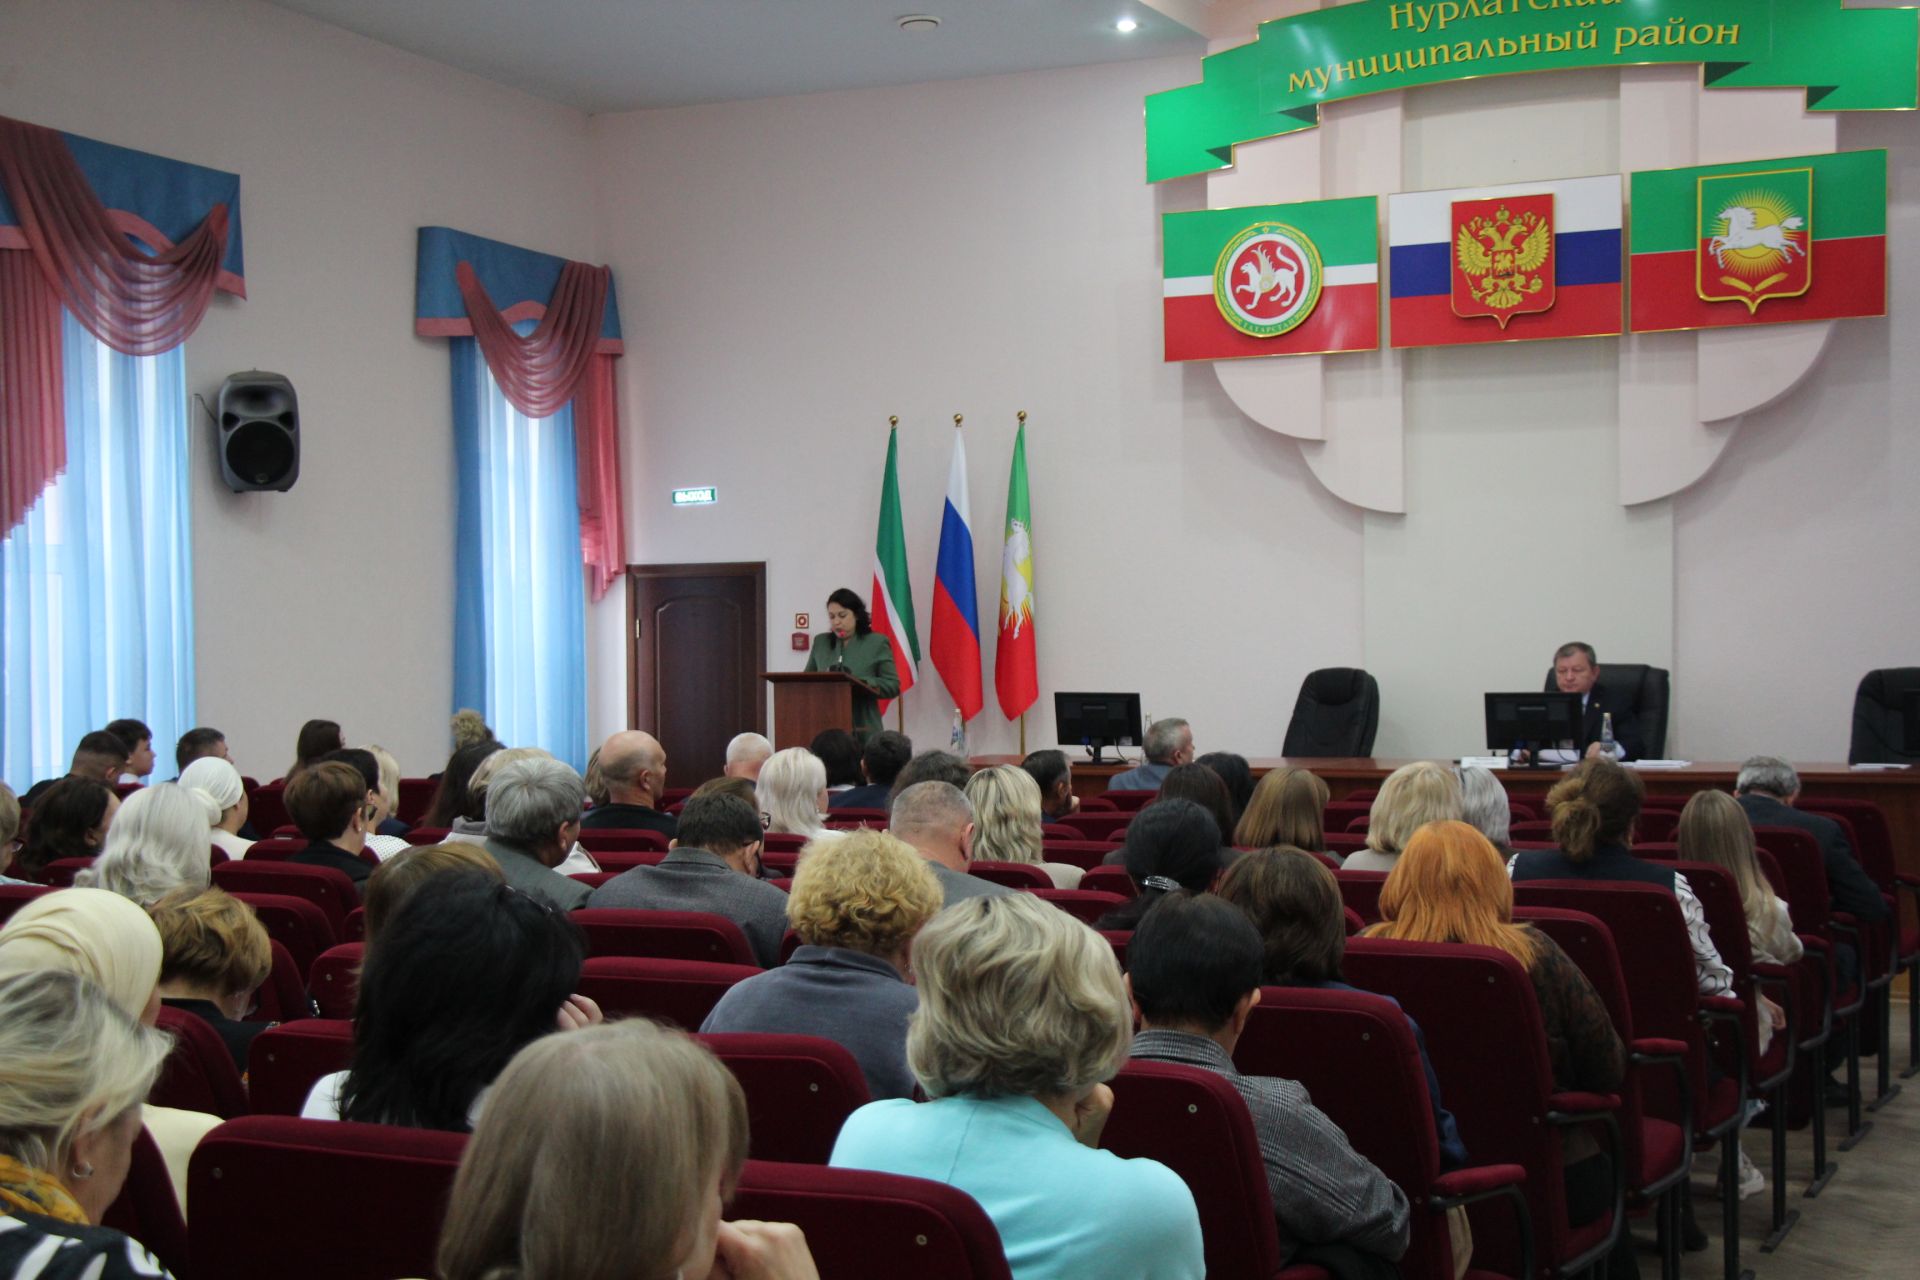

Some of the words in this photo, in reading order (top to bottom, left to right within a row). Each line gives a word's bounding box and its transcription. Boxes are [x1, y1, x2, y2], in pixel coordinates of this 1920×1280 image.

[1389, 0, 1622, 32] Нурлатс
[1288, 21, 1600, 94] муниципальный
[1613, 17, 1741, 54] район
